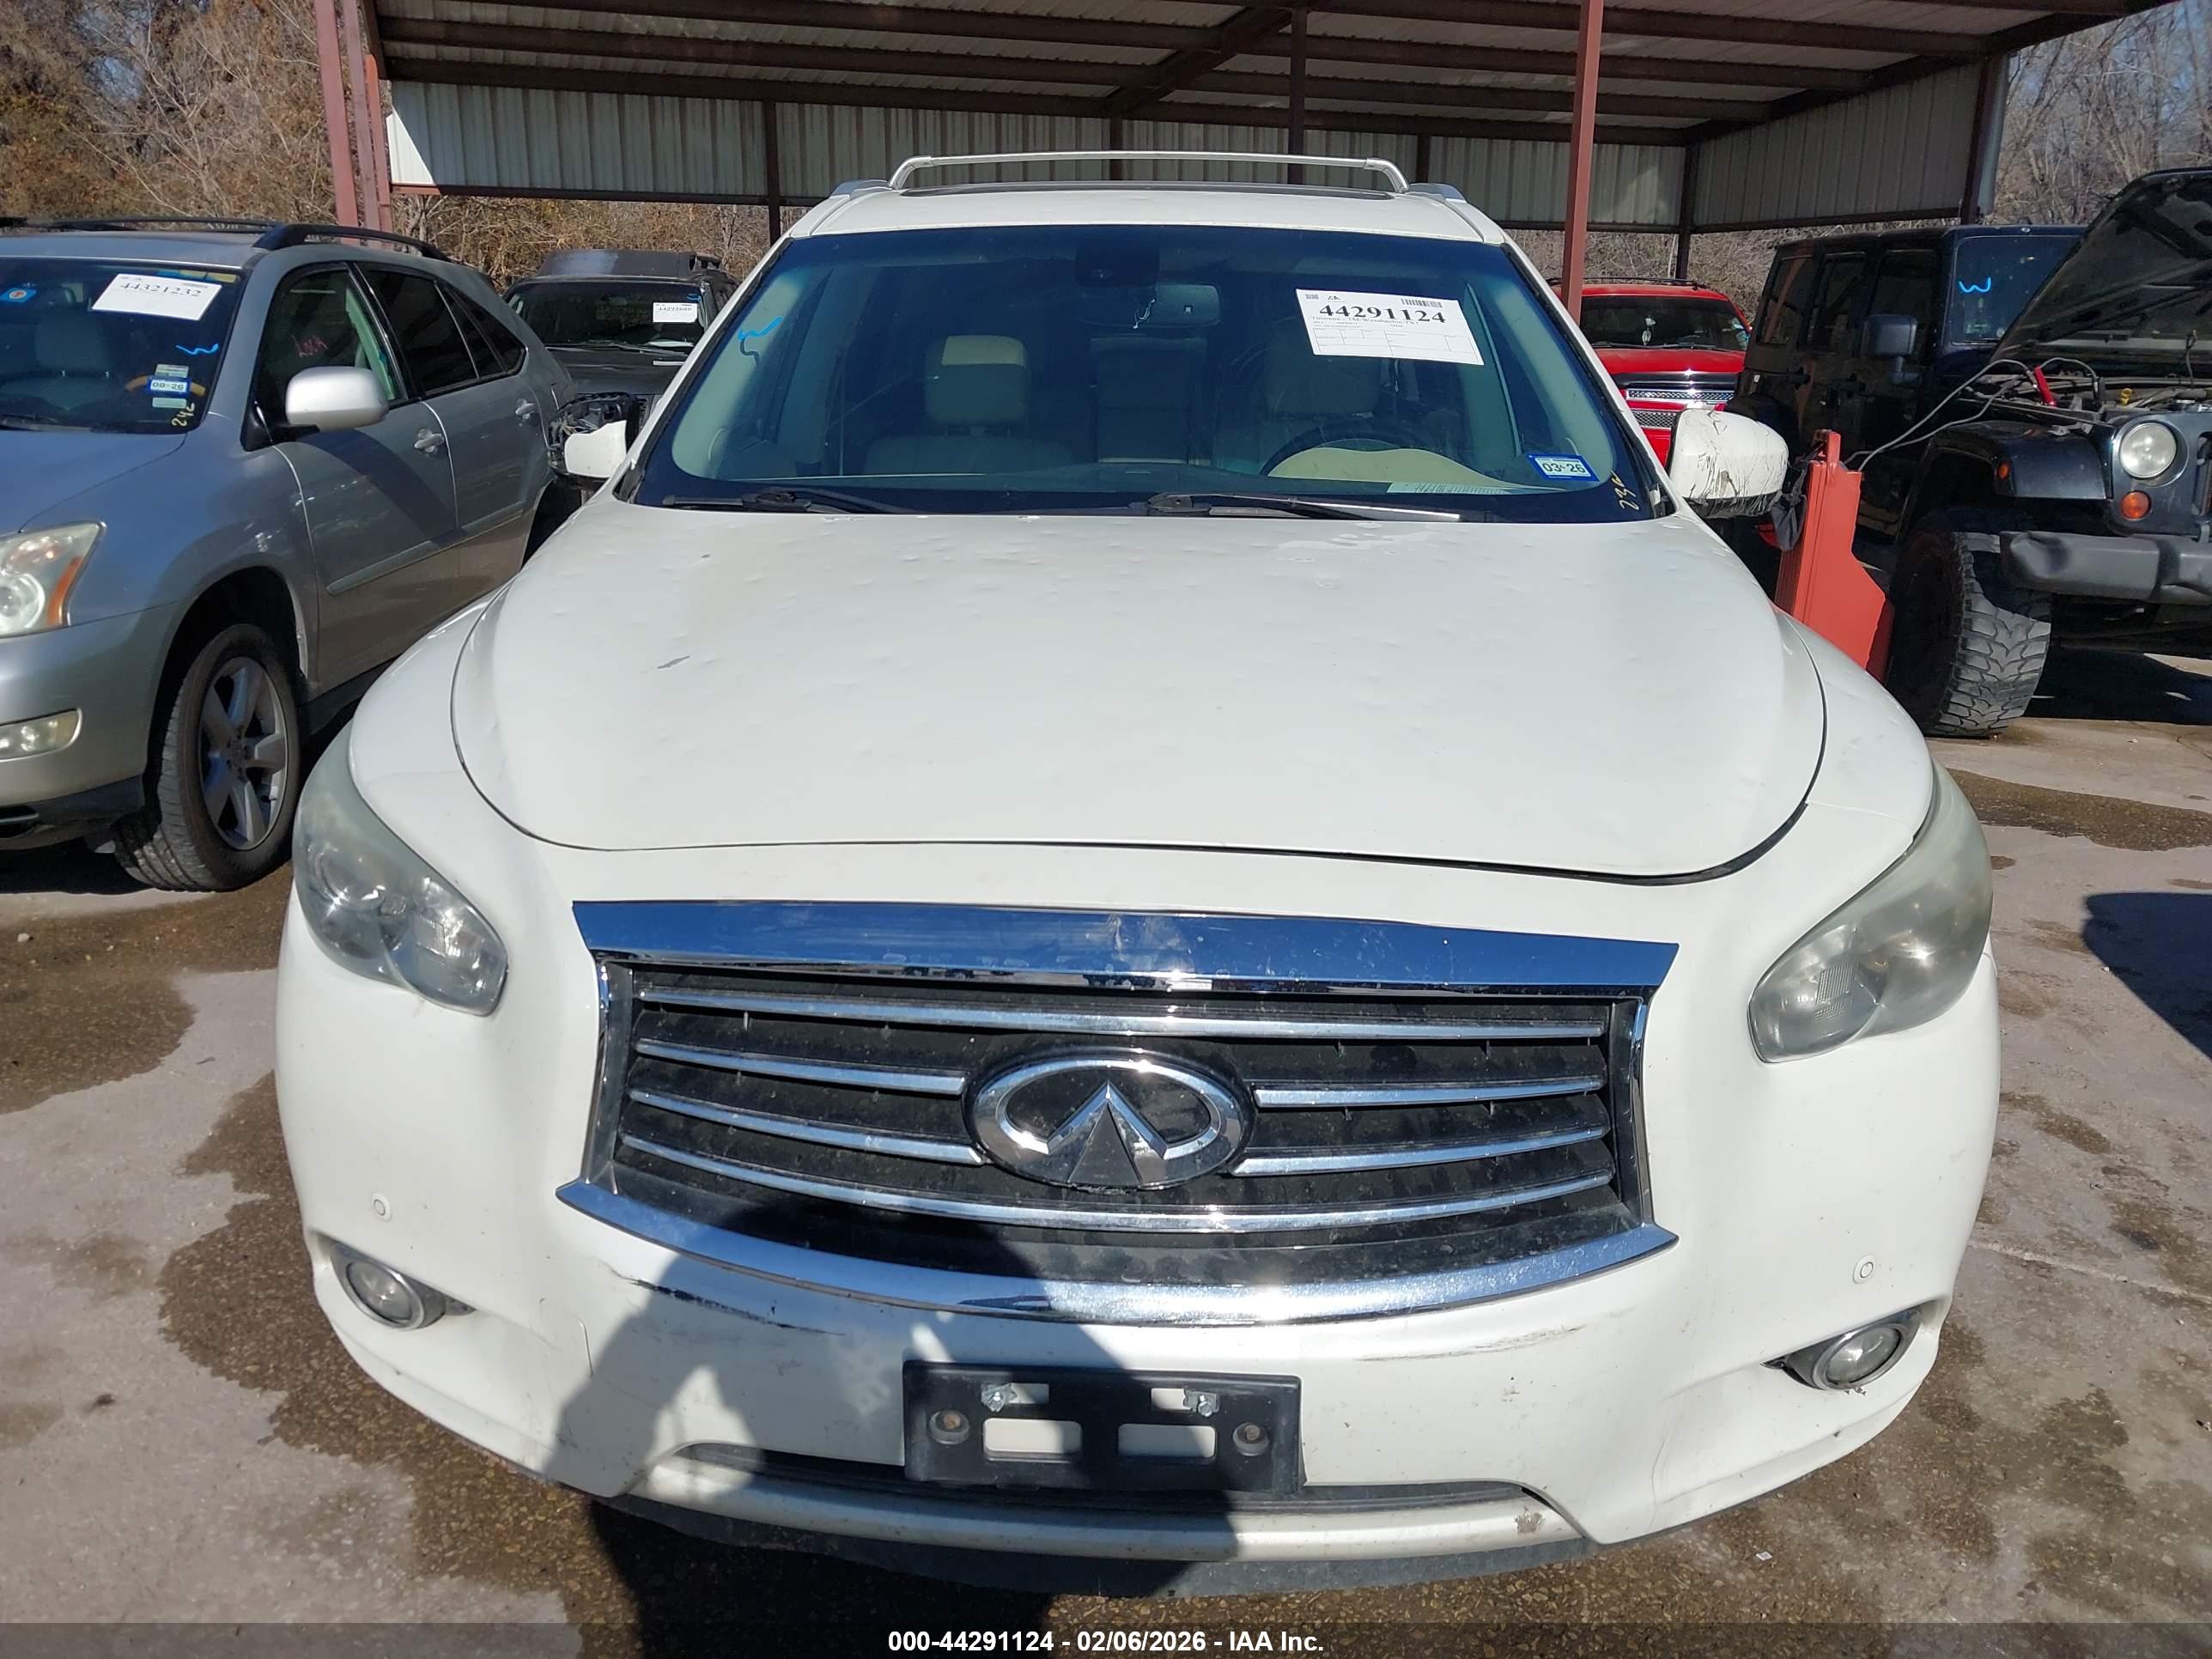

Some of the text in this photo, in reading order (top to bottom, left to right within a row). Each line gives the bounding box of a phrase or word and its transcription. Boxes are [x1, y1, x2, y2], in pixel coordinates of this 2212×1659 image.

[119, 283, 201, 297] 44321232
[1319, 304, 1446, 324] 44291124
[1541, 463, 1586, 473] 03 26
